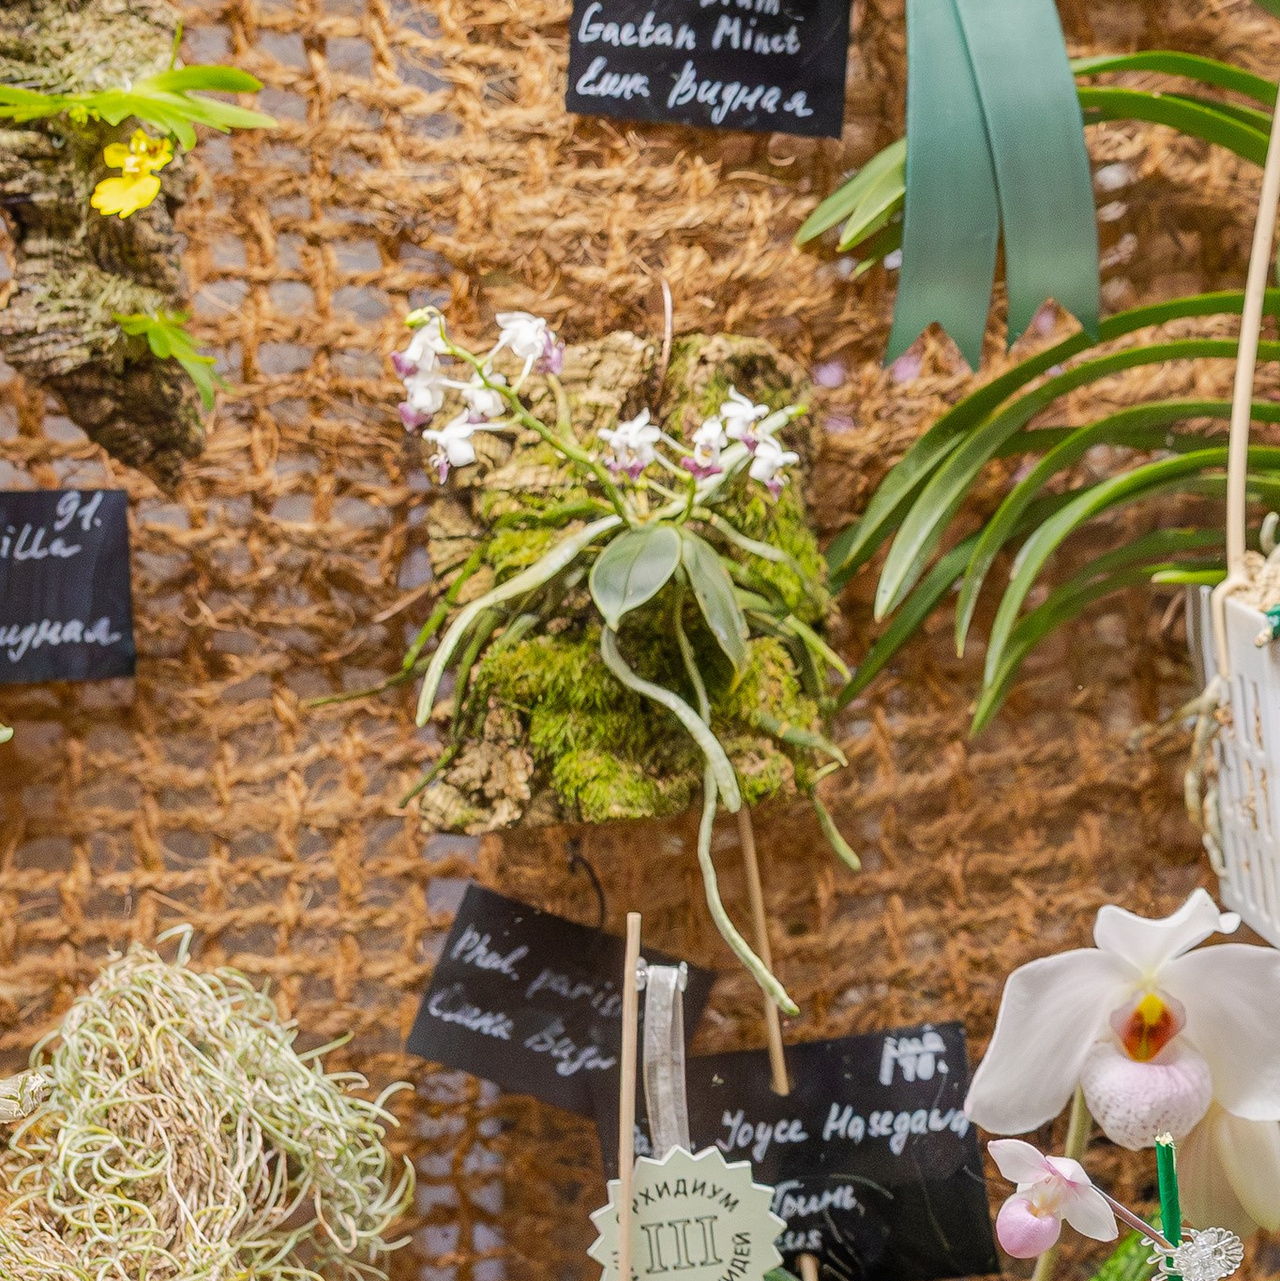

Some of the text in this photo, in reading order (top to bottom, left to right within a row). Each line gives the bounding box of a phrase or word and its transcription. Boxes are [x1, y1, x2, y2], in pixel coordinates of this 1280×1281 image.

[667, 60, 814, 125] Видная
[616, 1178, 740, 1224] РХИДИУМ
[640, 1215, 723, 1275] III
